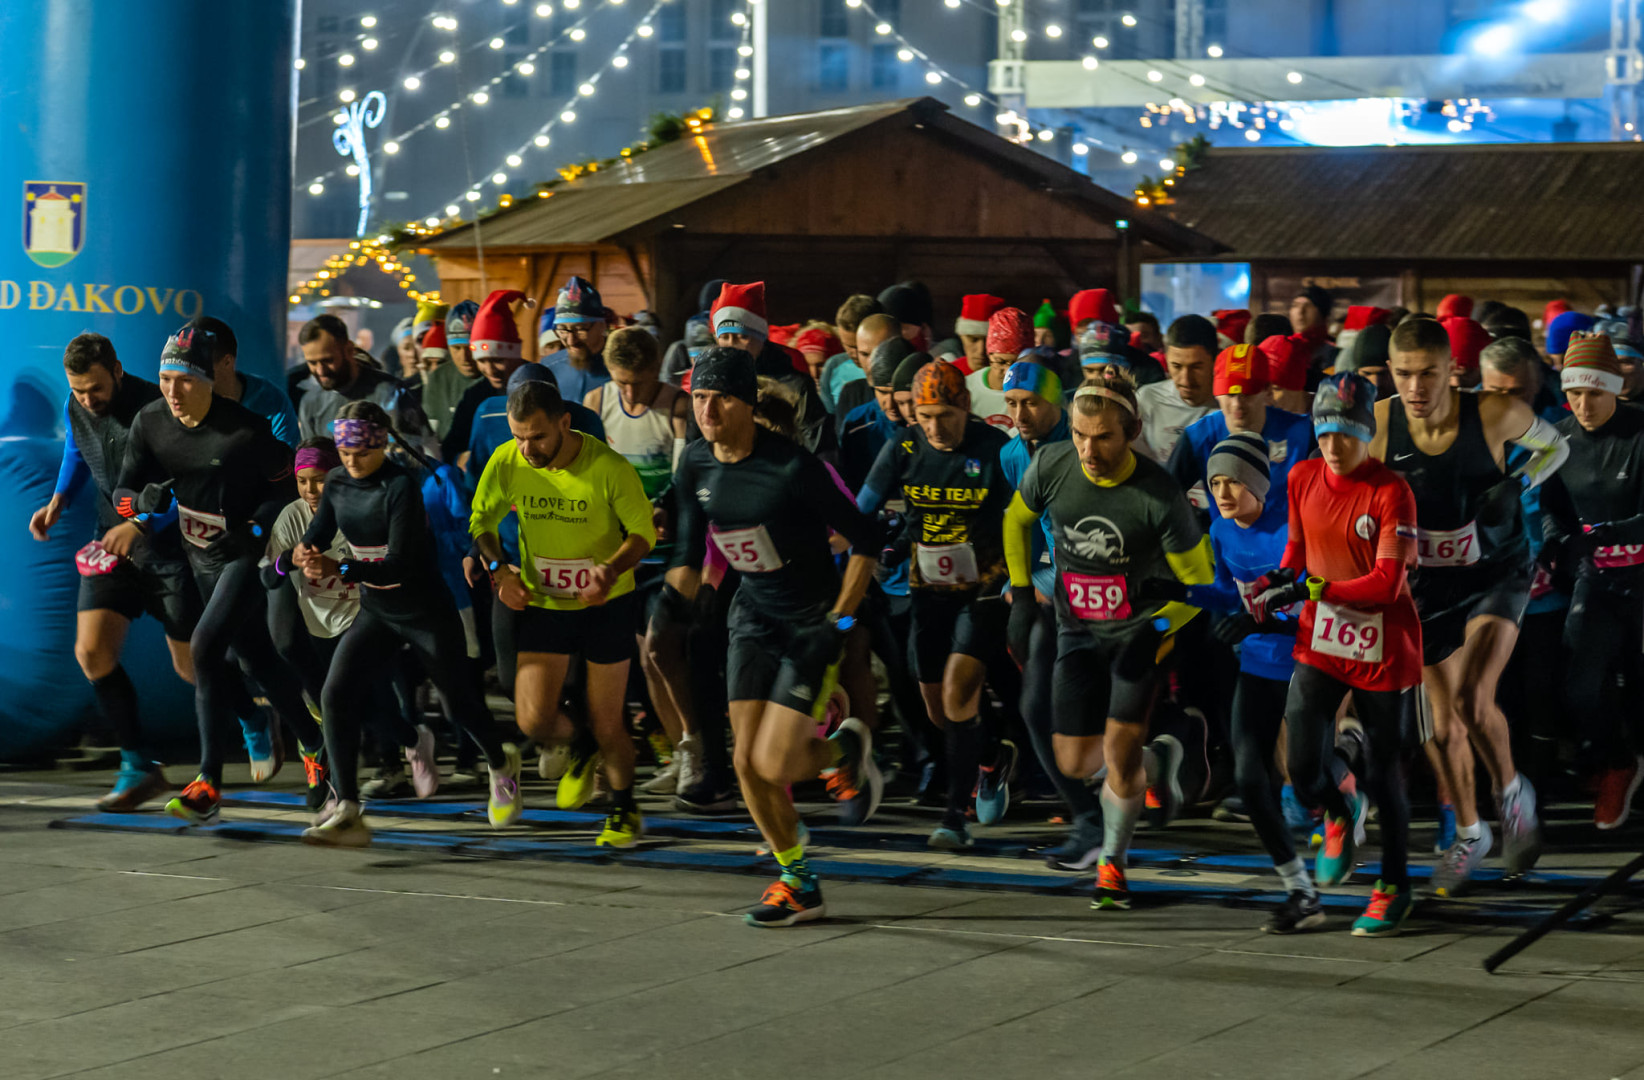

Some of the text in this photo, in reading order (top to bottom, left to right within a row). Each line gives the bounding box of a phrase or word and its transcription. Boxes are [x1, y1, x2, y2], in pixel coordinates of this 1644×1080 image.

[28, 281, 203, 318] ĐAKOVO
[530, 495, 564, 511] LOVE
[568, 499, 588, 512] TO
[944, 487, 989, 502] TEAM
[723, 540, 759, 563] 55
[1418, 533, 1474, 558] 167
[77, 545, 119, 572] 204
[937, 555, 954, 577] 9
[540, 567, 591, 589] 150
[1070, 583, 1124, 610] 259
[1317, 617, 1379, 650] 169
